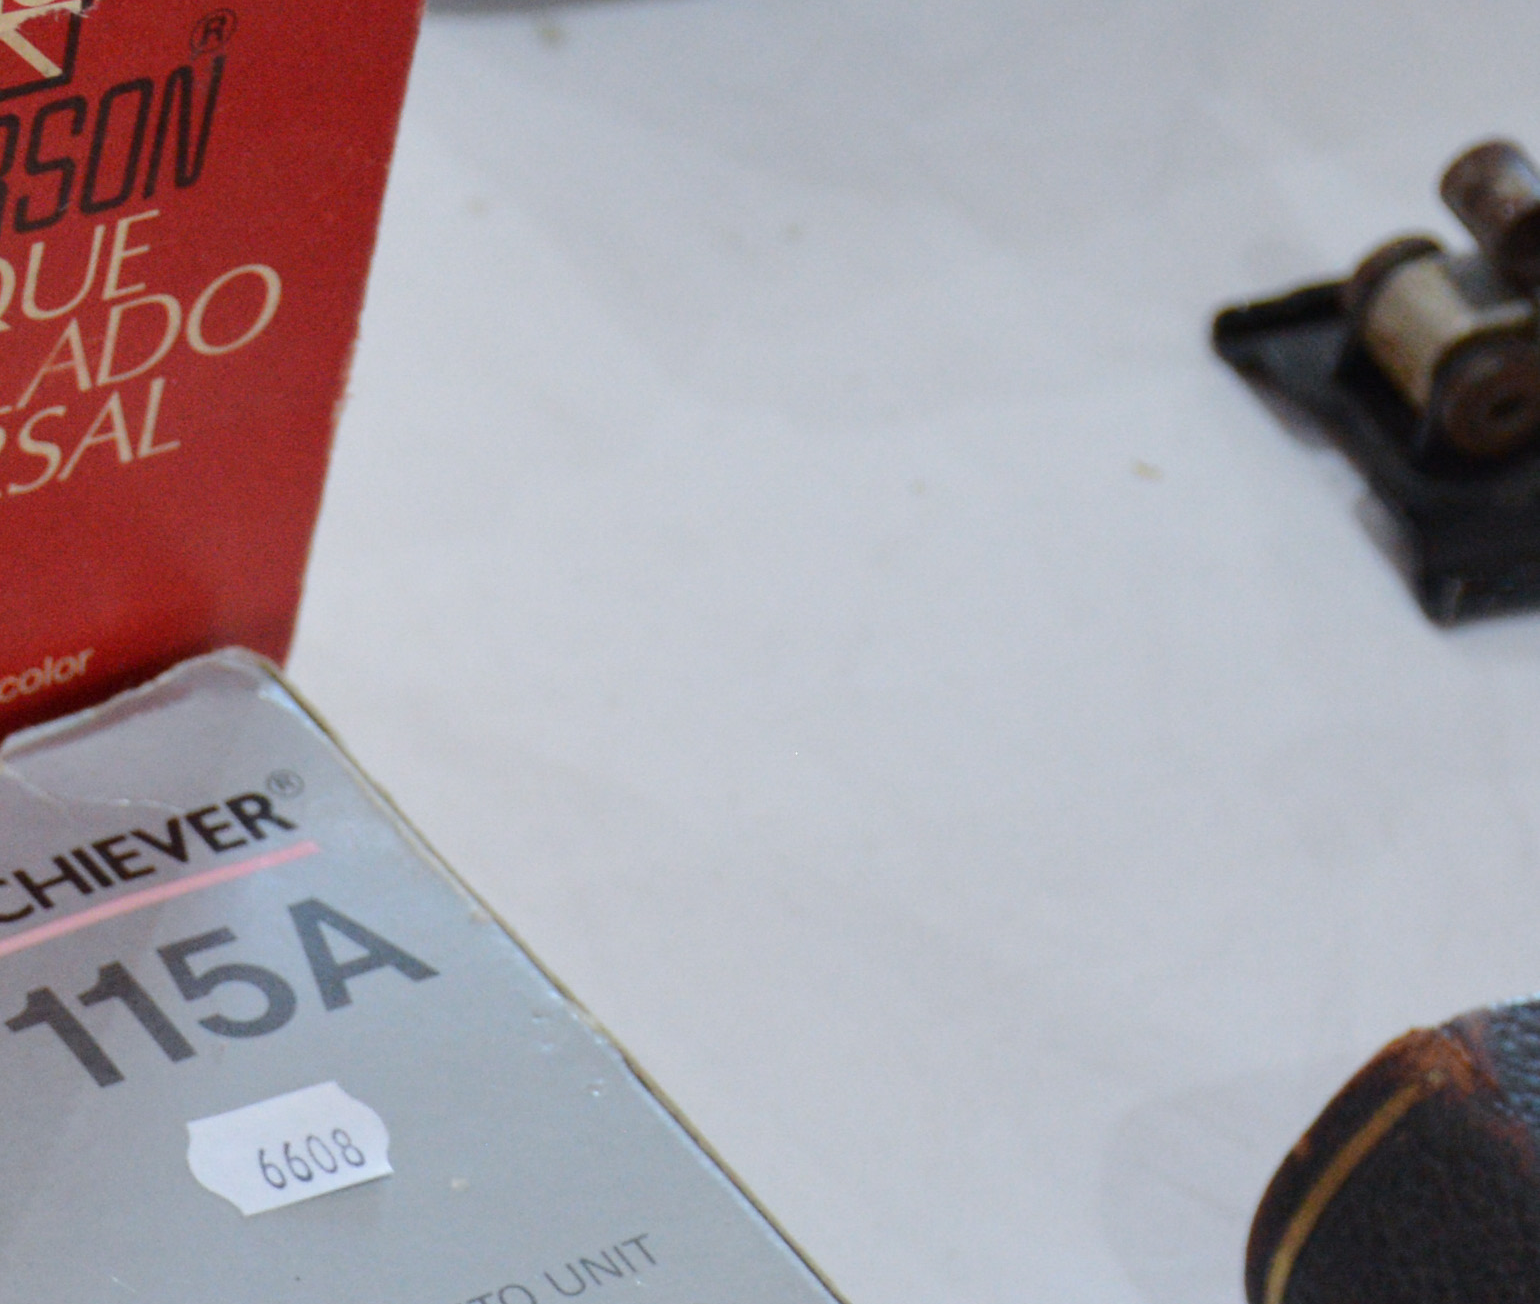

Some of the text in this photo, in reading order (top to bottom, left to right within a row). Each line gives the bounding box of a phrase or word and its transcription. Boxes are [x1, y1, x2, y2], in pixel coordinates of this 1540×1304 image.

[4, 896, 440, 1088] 115A
[257, 1128, 366, 1190] 6608
[544, 1232, 660, 1298] UNIT
